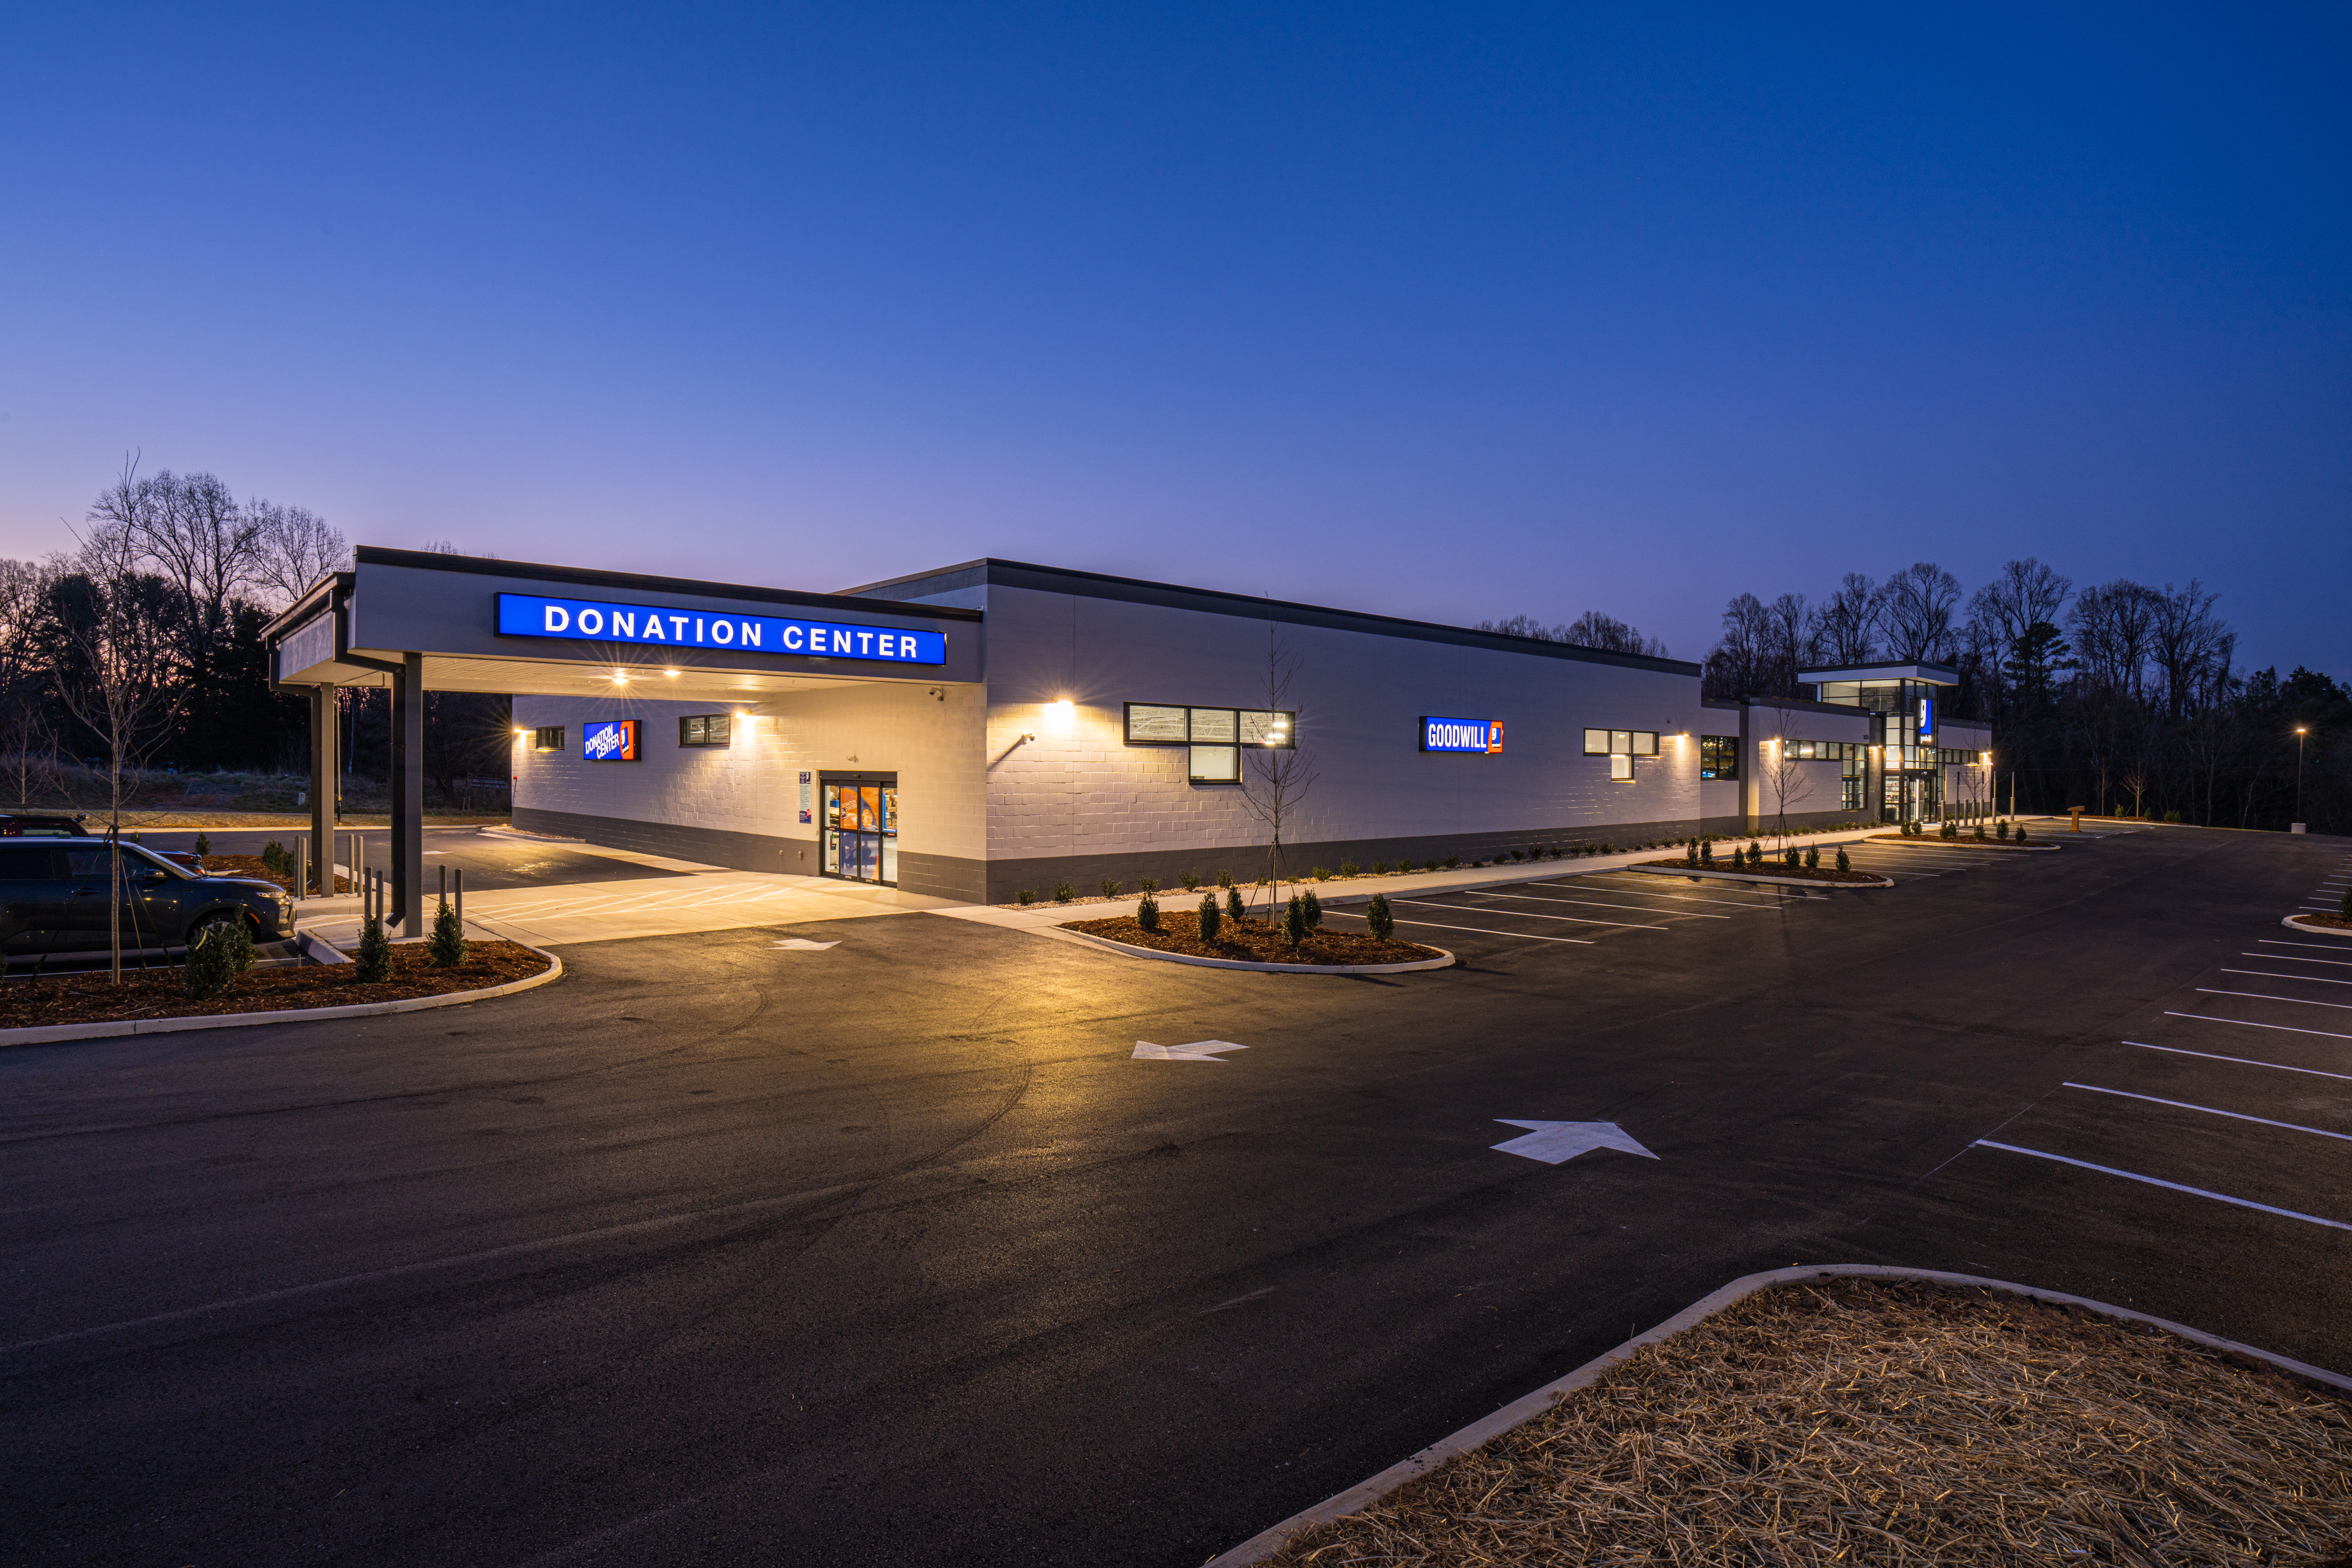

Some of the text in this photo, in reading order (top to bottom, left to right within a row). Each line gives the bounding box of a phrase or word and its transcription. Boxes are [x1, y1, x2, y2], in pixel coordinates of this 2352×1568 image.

[545, 605, 917, 658] DONATION CENTER
[585, 724, 613, 754] DONATION
[597, 733, 619, 759] CENTER
[1428, 724, 1487, 748] GOODWILL
[842, 799, 856, 808] DONATION
